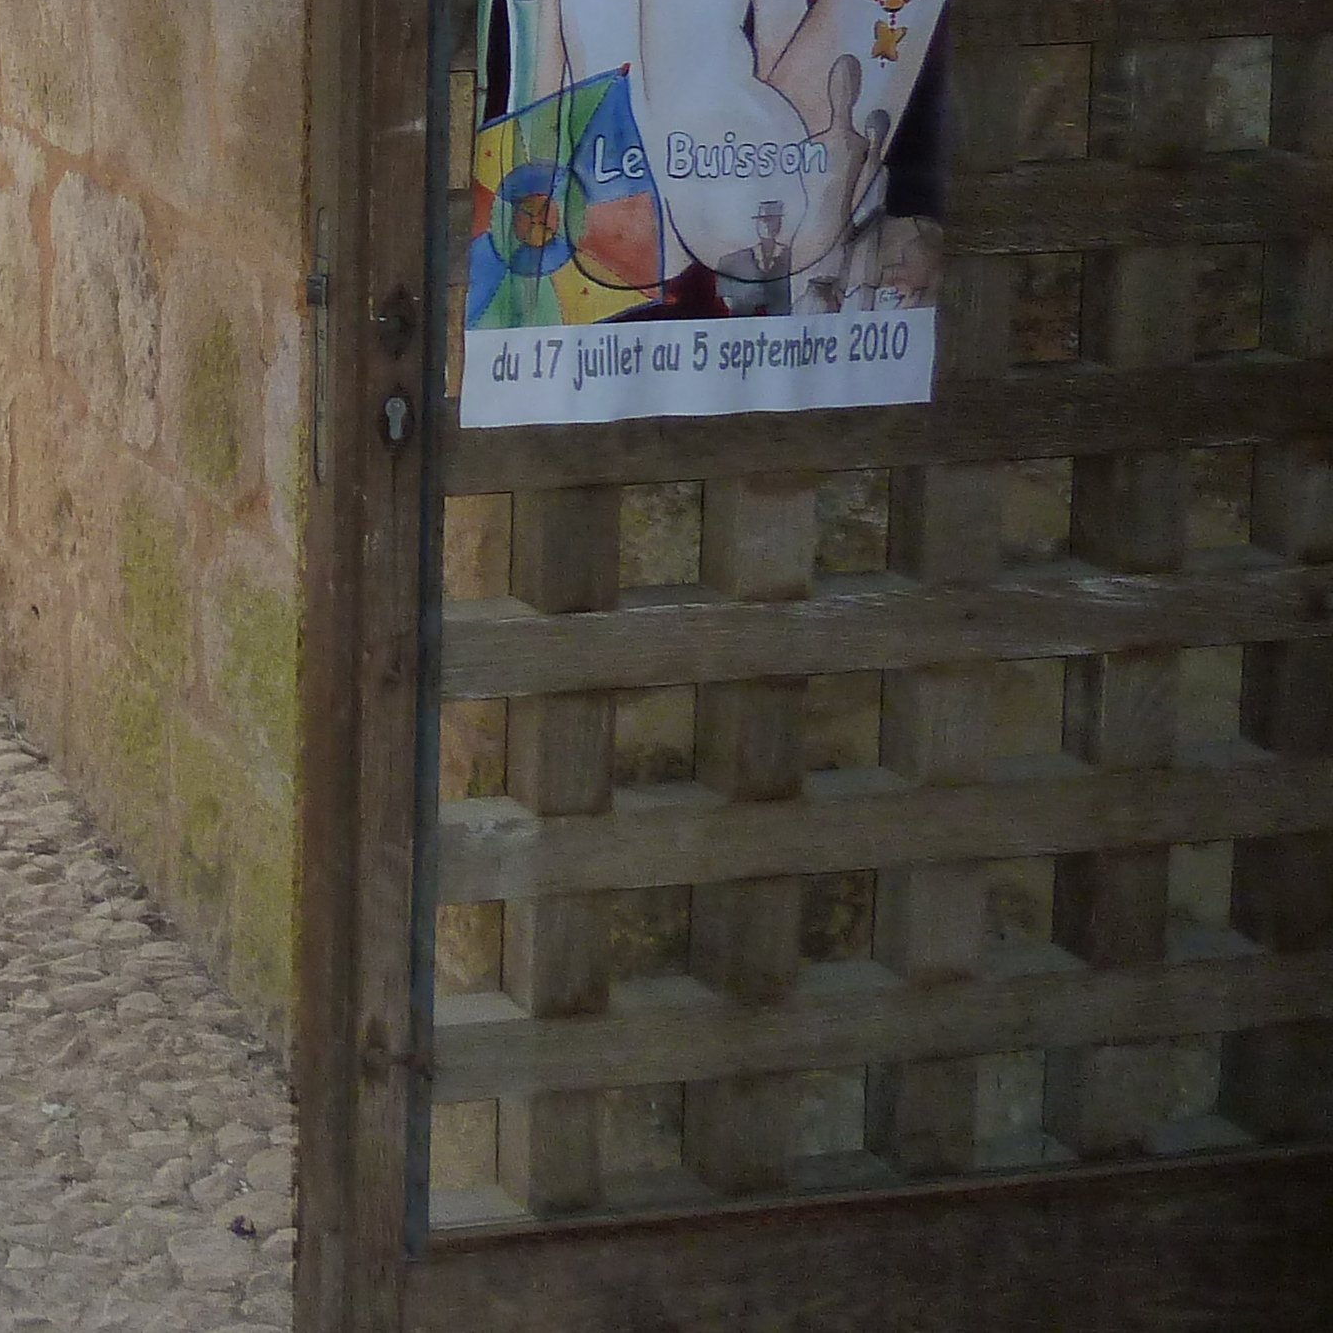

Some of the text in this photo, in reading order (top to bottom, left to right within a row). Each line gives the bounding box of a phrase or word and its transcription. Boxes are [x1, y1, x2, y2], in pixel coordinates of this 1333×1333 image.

[593, 131, 827, 184] Le Buisson
[493, 321, 908, 391] du 17 juillet au 5 septembre 2010
